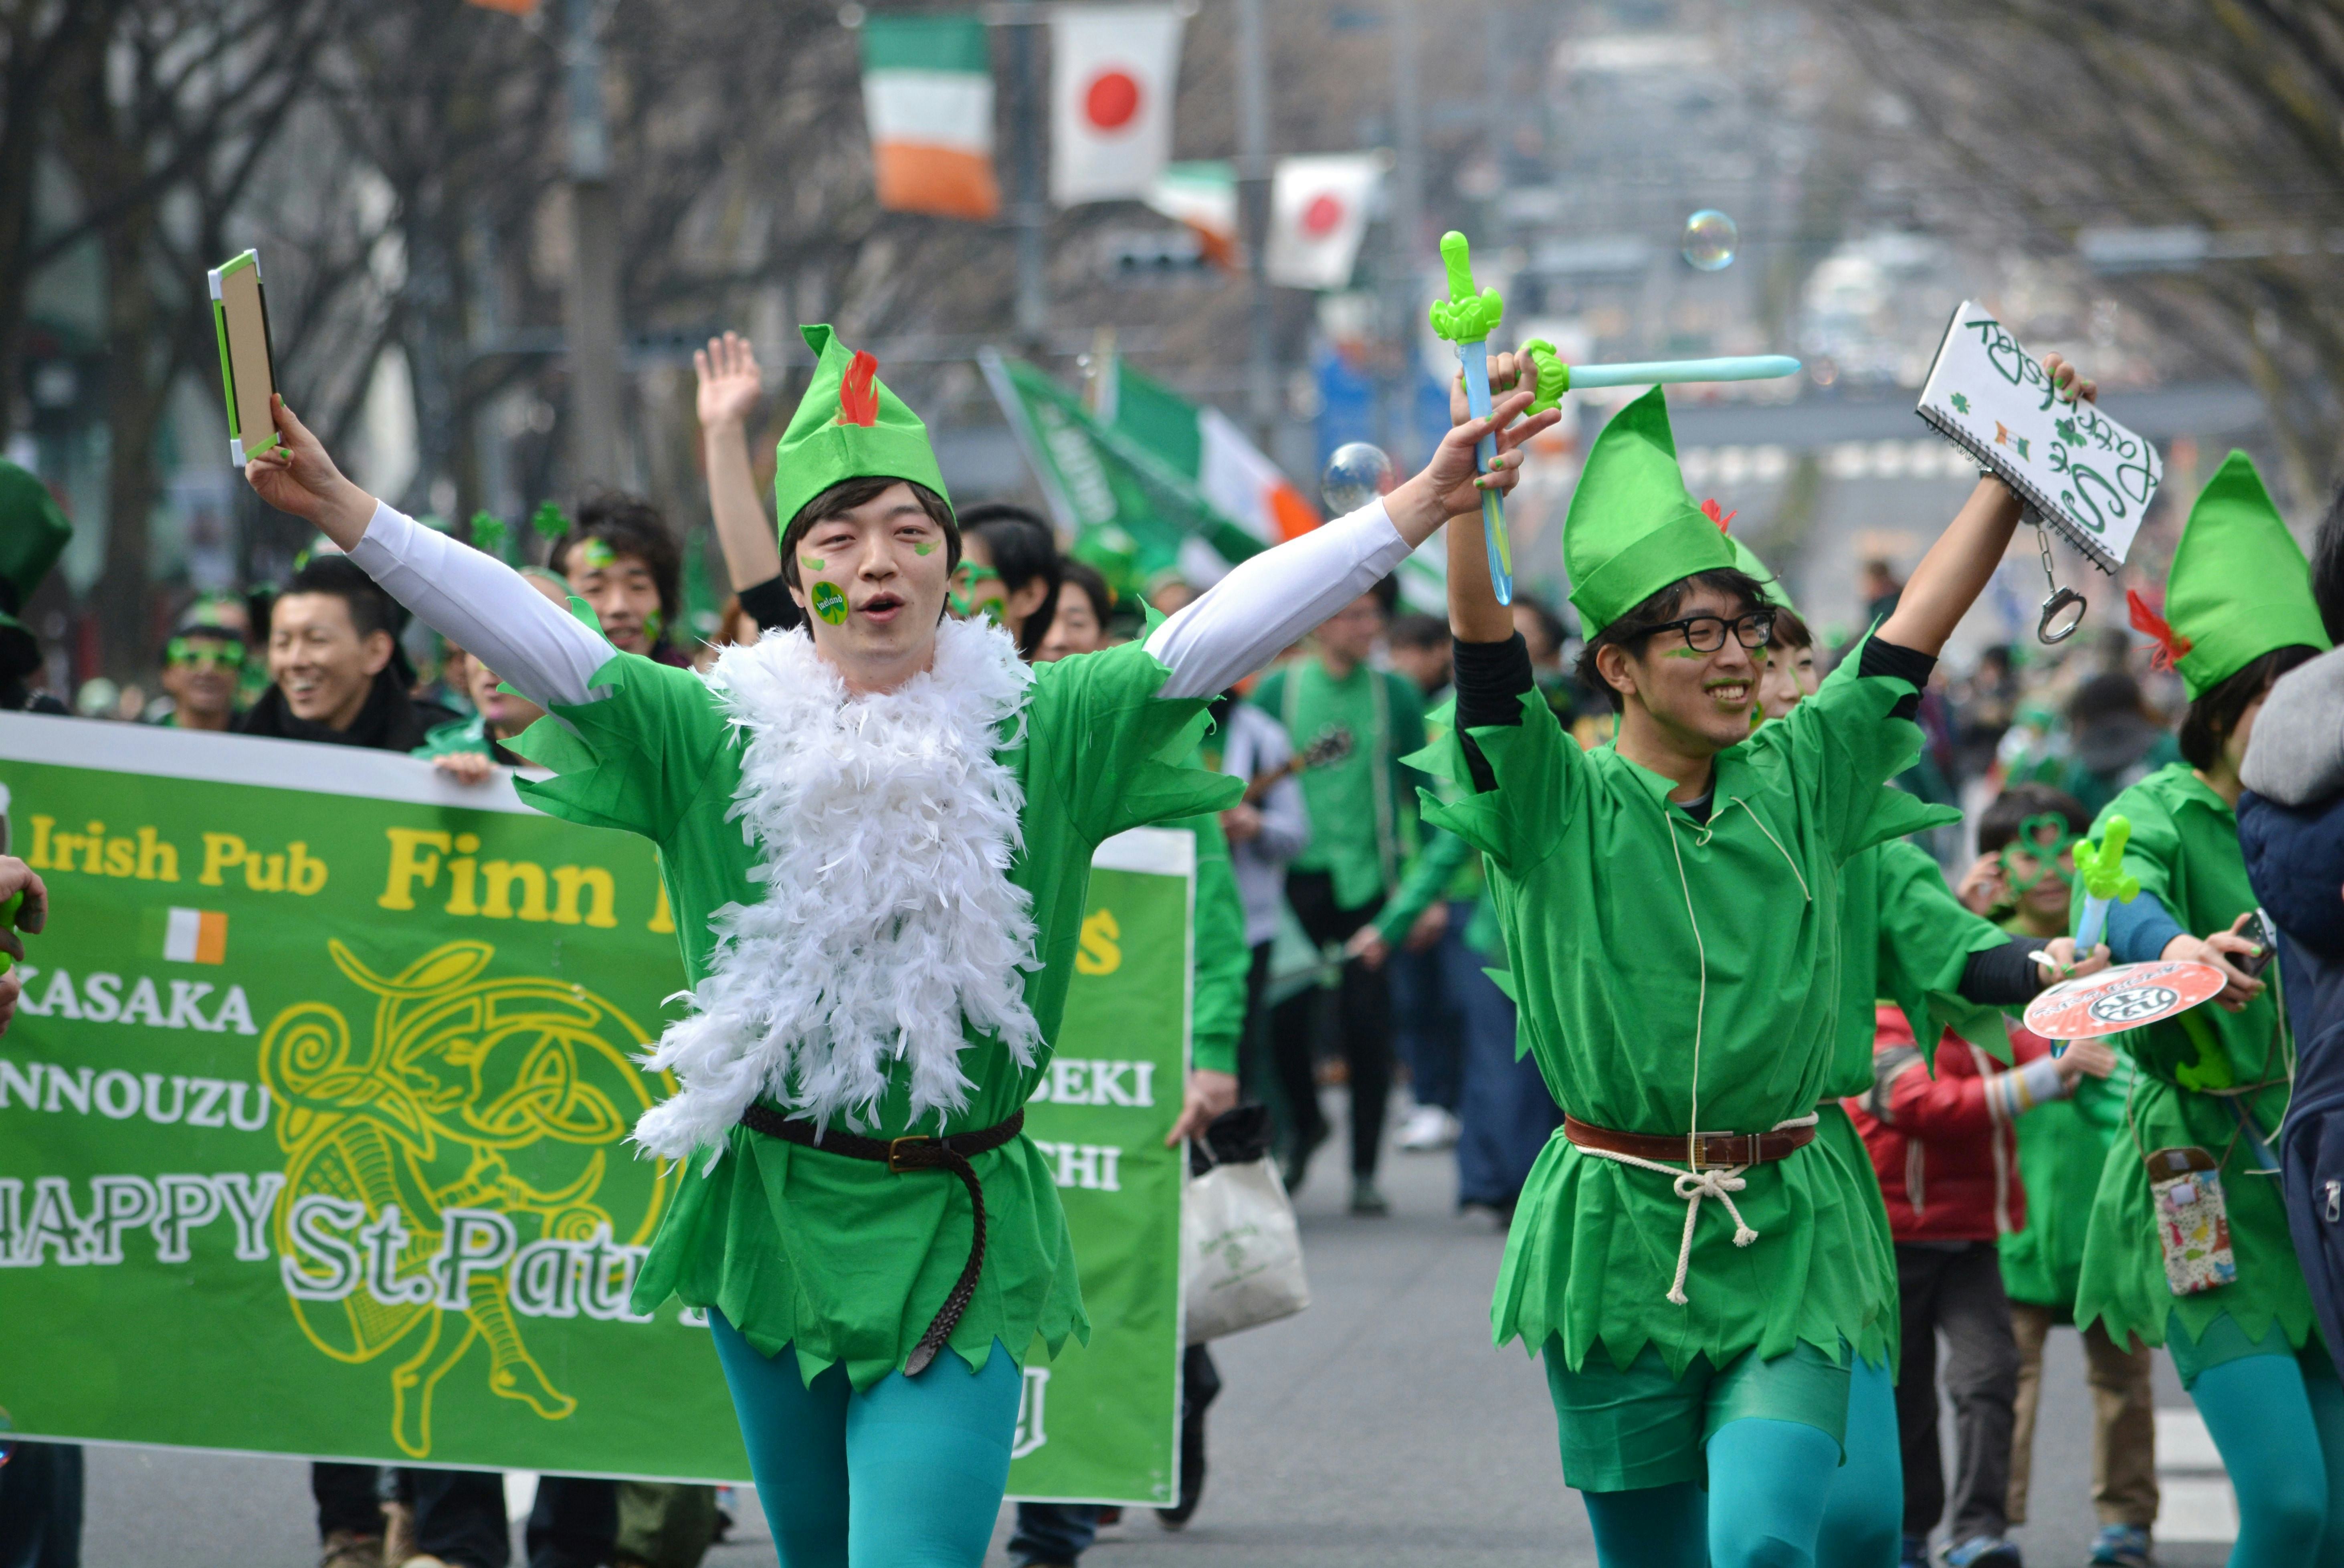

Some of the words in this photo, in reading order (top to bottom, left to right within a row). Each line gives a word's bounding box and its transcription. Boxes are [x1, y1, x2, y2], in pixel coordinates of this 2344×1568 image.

[816, 594, 843, 610] Ireland
[27, 814, 180, 882] Irish
[198, 832, 328, 896] Pub
[377, 826, 618, 928] Finn
